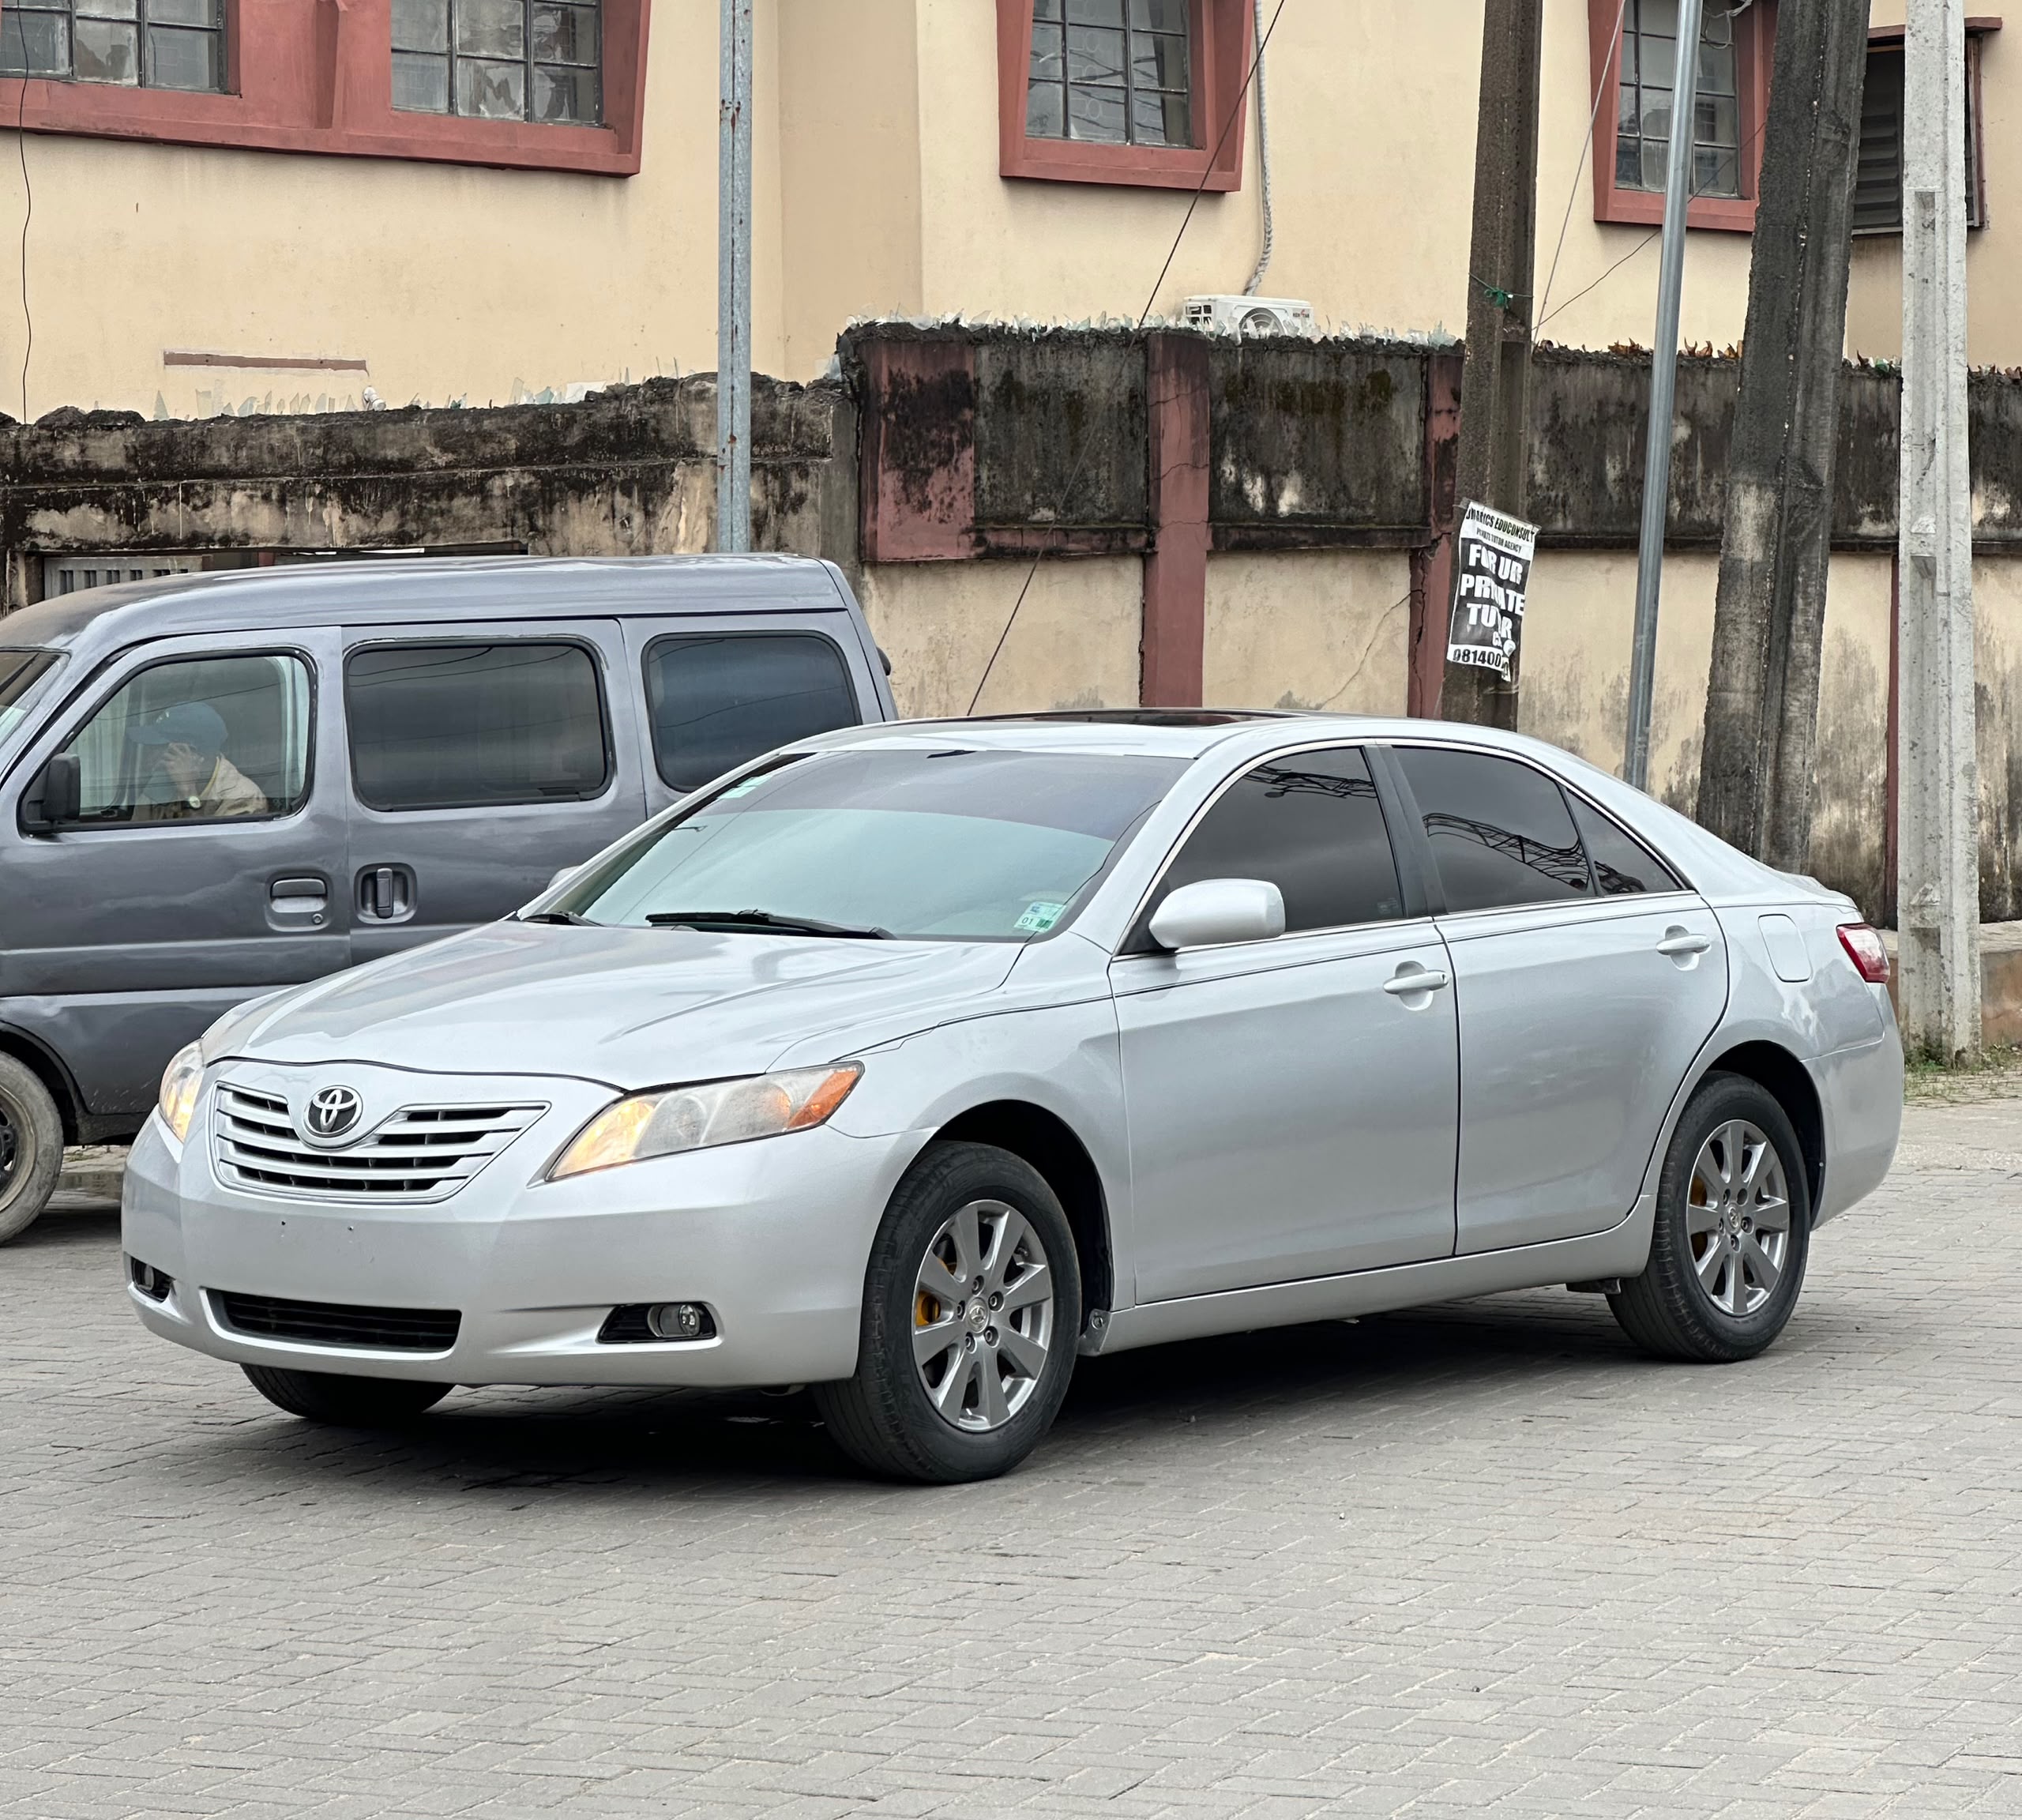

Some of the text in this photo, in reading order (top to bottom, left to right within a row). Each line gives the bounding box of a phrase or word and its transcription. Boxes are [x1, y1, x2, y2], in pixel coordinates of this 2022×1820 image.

[1494, 517, 1535, 543] EDUCONSULT
[1504, 540, 1522, 554] AGENCY
[1498, 555, 1523, 585] UR
[1021, 916, 1034, 925] 01
